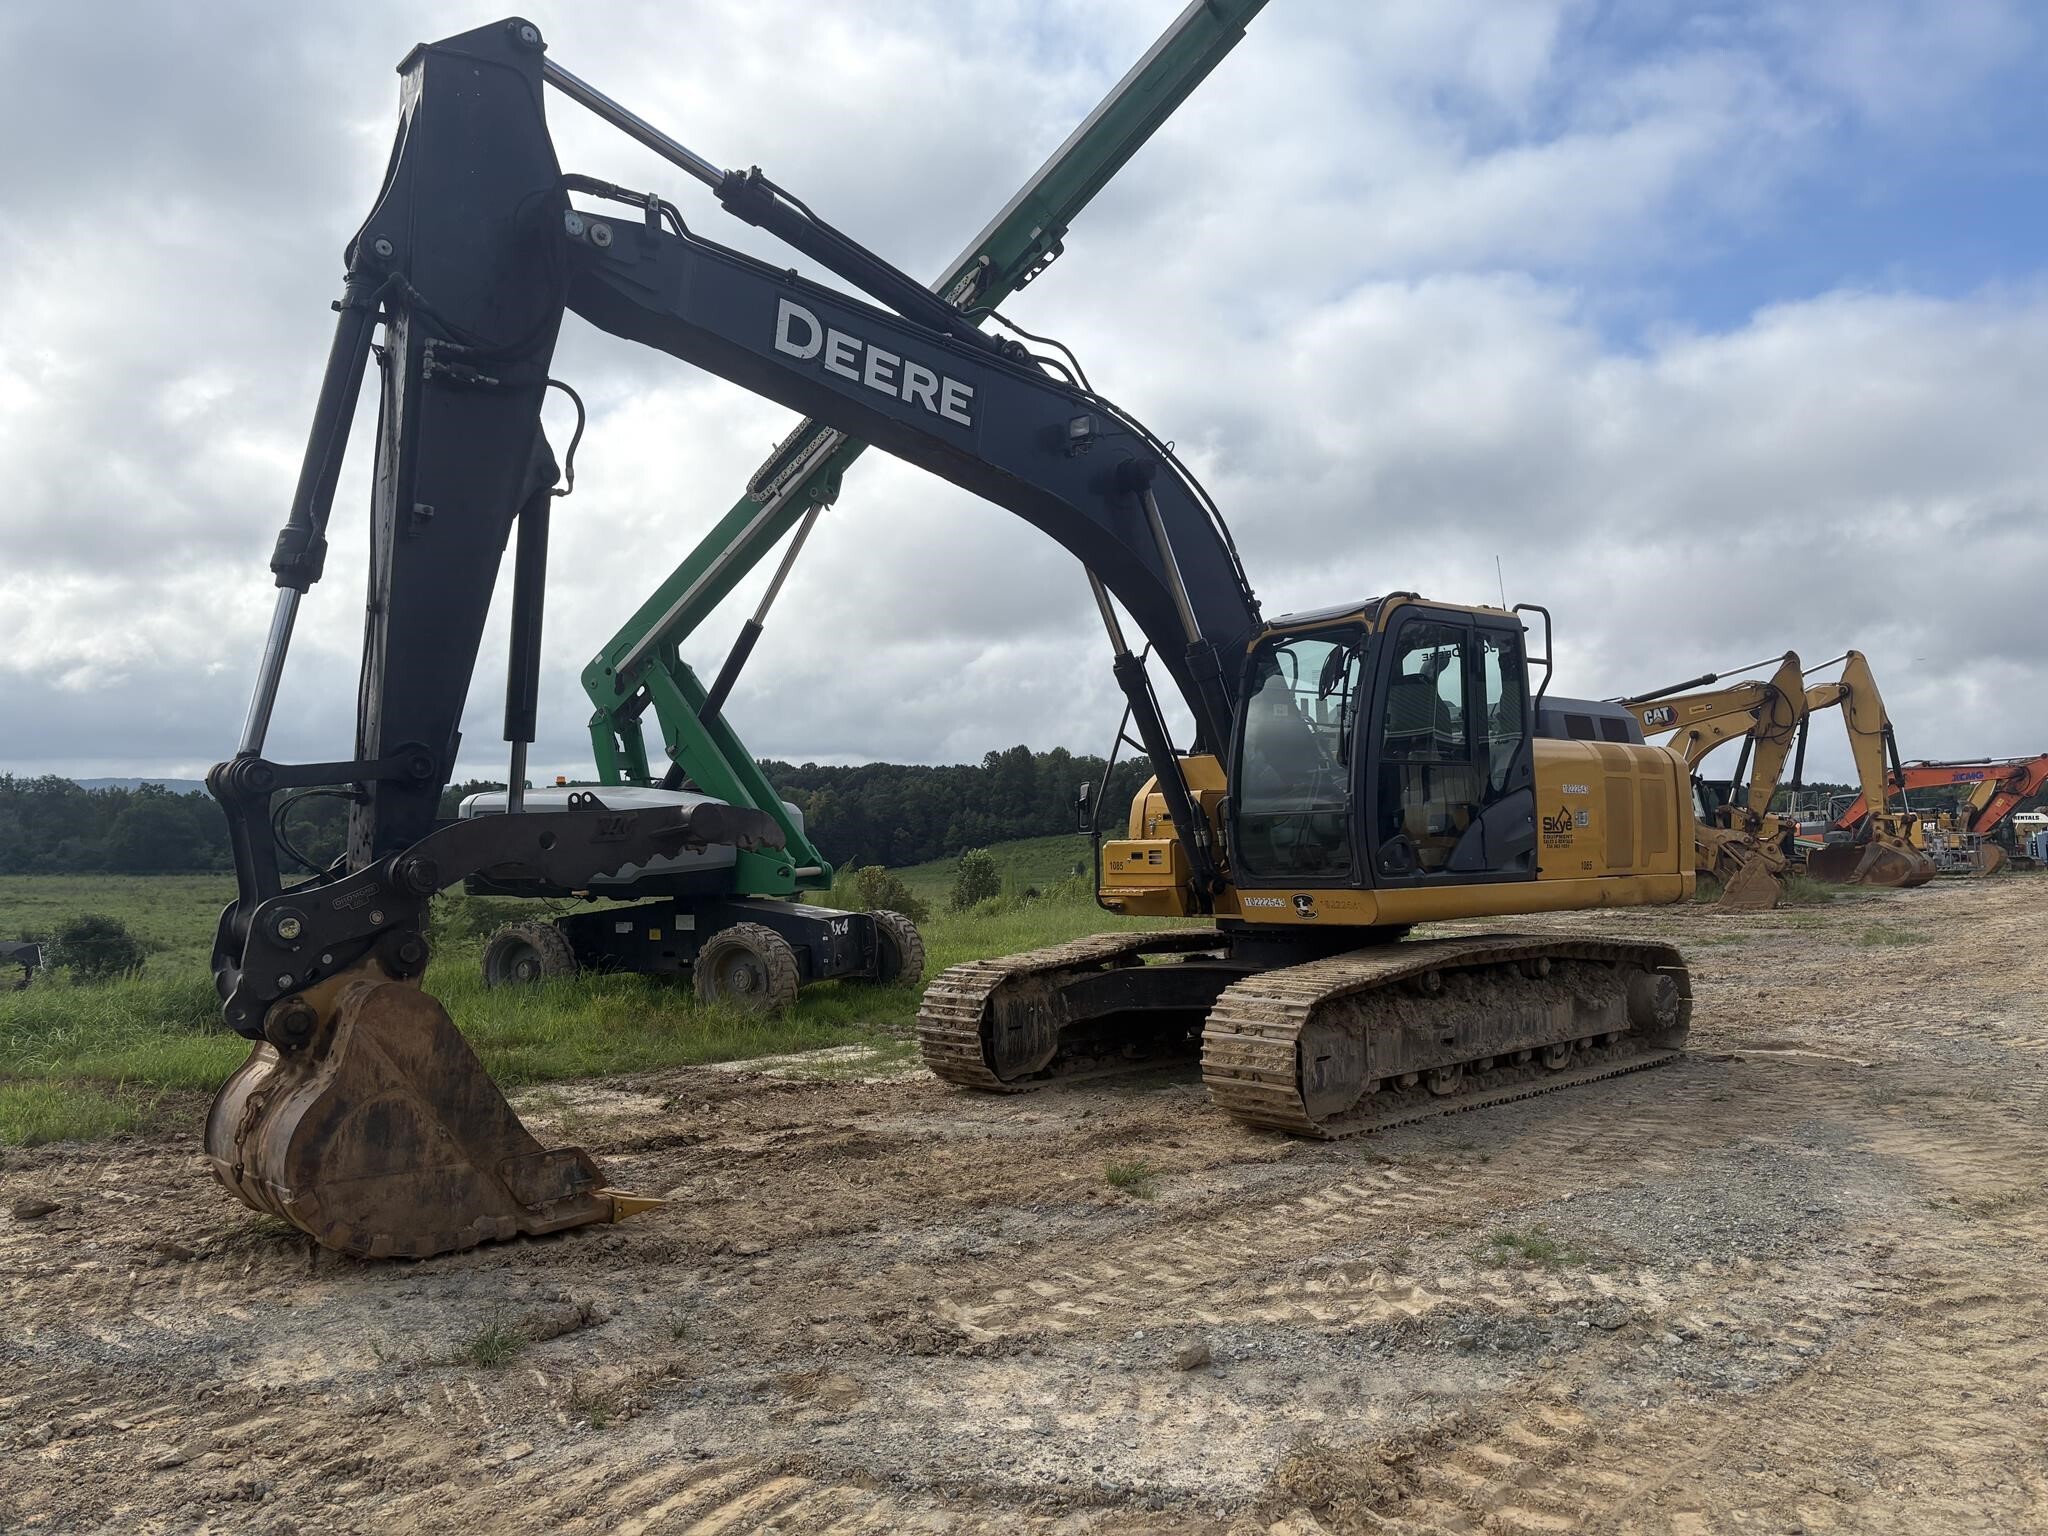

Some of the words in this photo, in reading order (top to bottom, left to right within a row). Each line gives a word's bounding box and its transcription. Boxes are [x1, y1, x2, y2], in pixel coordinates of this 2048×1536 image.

[775, 297, 974, 427] DEERE
[1643, 706, 1670, 726] CAT
[1543, 815, 1572, 833] Skye
[1923, 822, 1936, 830] CAT
[1110, 861, 1124, 870] 1085
[1244, 898, 1287, 908] 10222543
